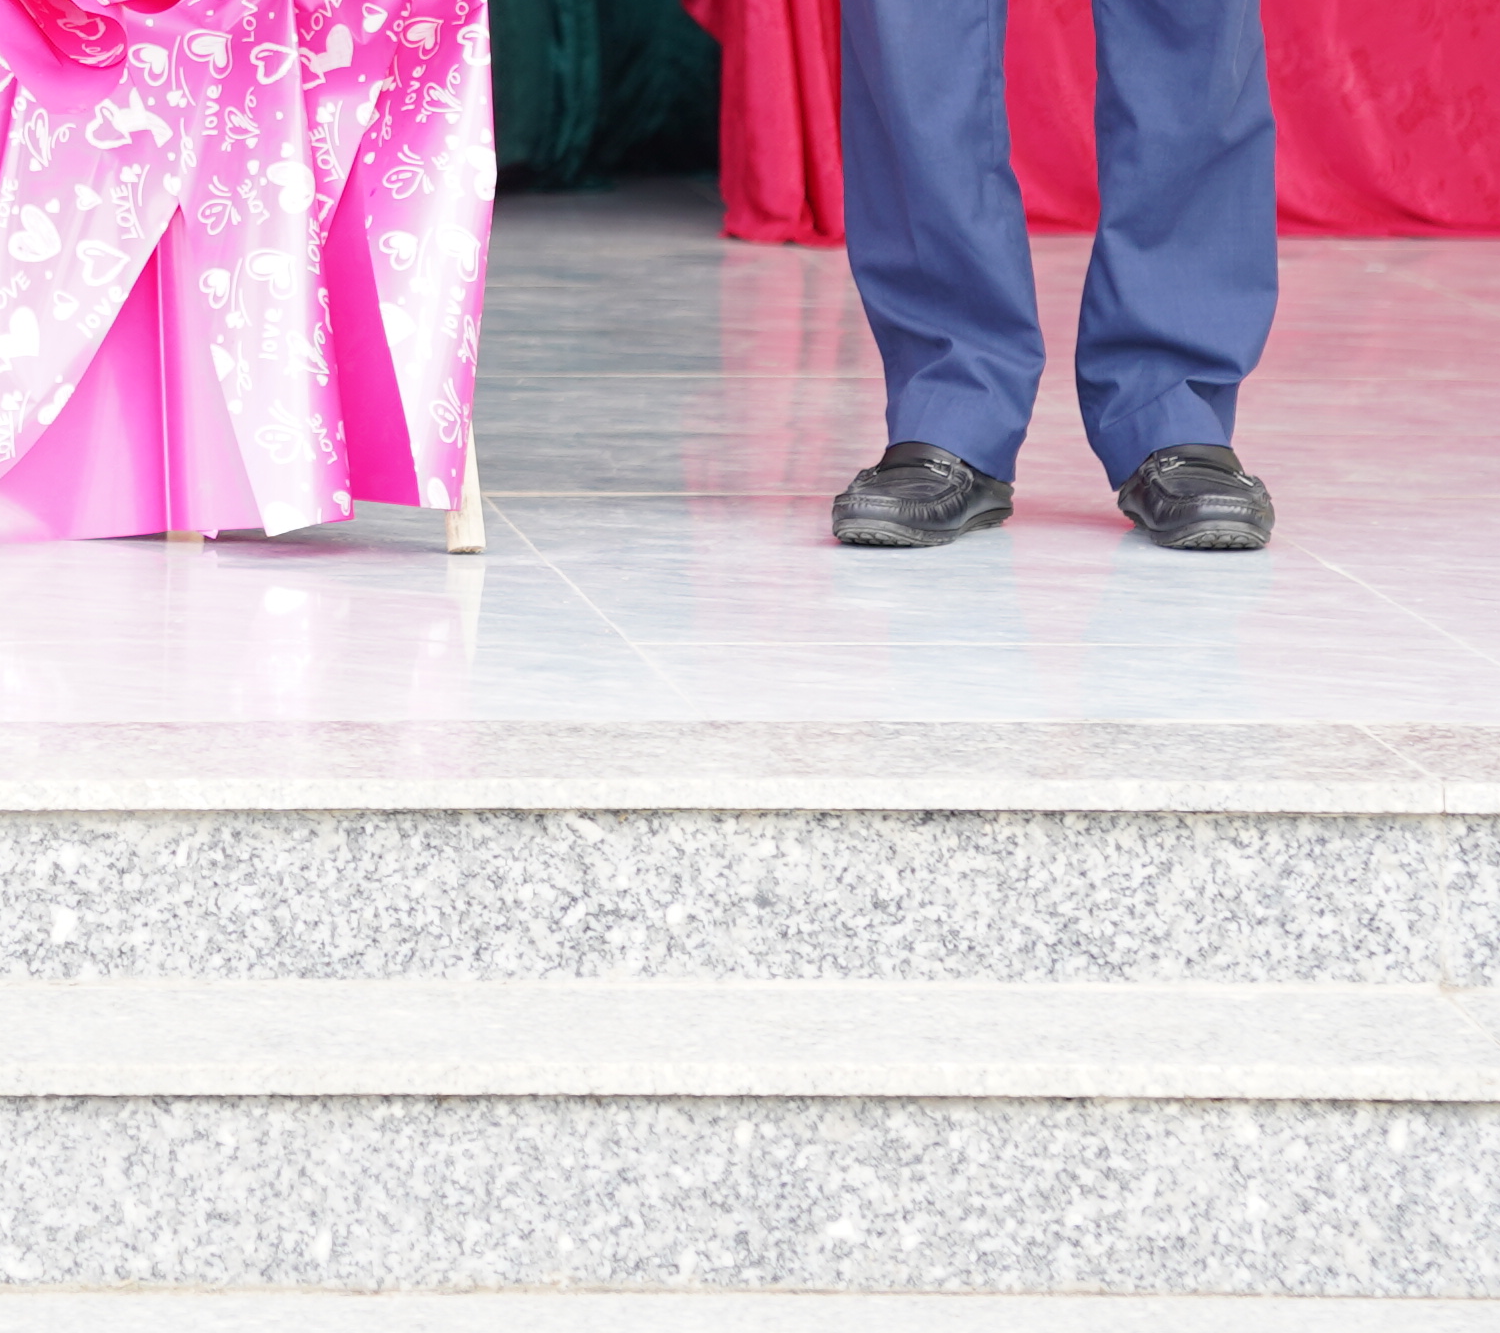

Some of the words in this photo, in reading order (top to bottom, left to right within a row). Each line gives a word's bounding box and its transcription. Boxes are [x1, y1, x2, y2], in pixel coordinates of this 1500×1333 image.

[201, 83, 223, 136] love
[400, 63, 426, 112] love
[309, 126, 339, 183] LOVE
[110, 184, 139, 241] LOVE
[305, 218, 321, 275] LOVE
[258, 307, 284, 361] love
[440, 285, 467, 339] love
